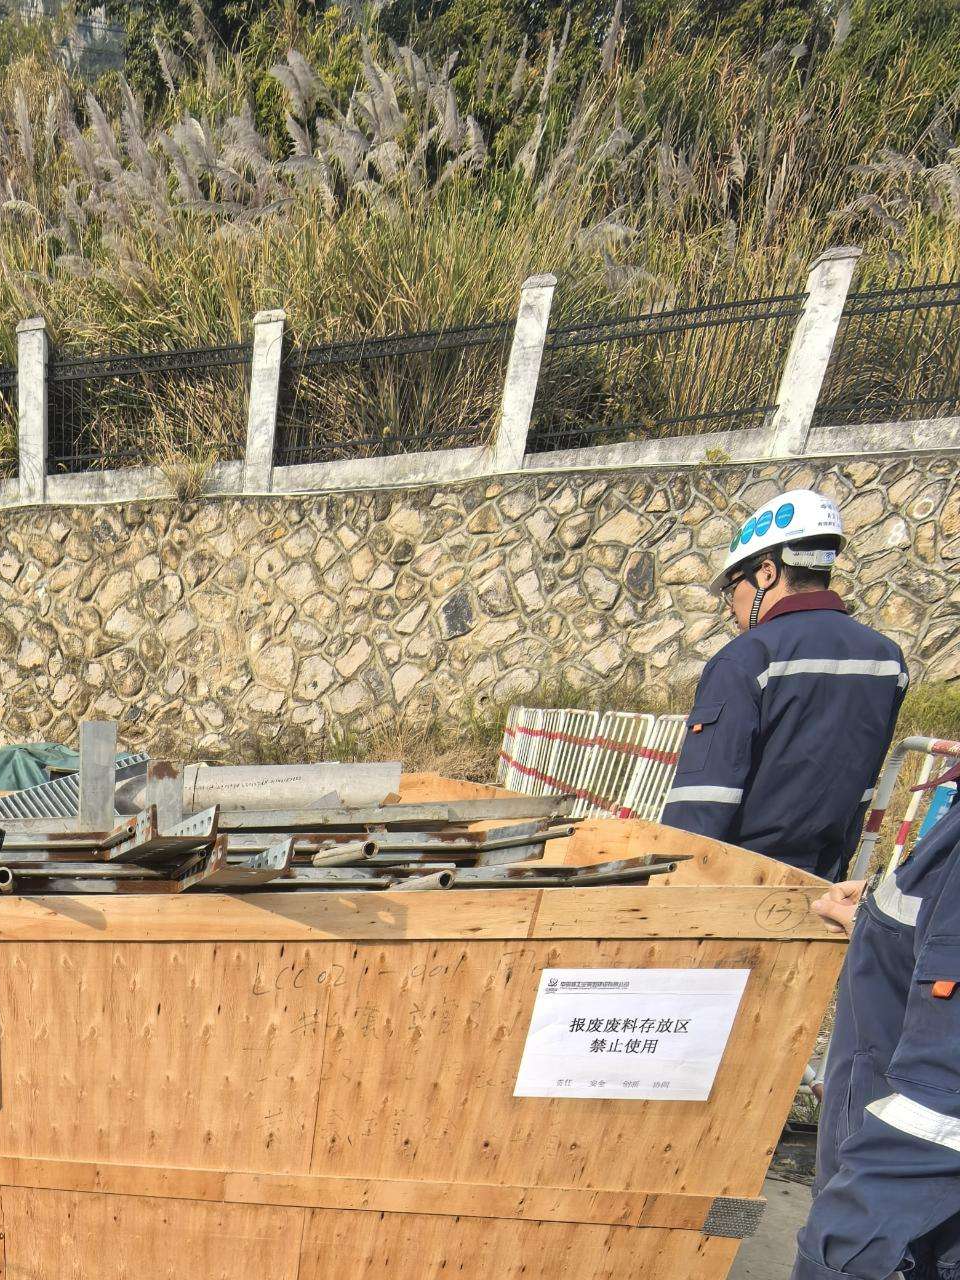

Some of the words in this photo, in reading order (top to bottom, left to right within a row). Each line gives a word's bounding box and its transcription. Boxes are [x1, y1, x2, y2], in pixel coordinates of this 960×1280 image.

[569, 1017, 692, 1034] 报废废料存放区
[589, 1038, 659, 1054] 禁止使用
